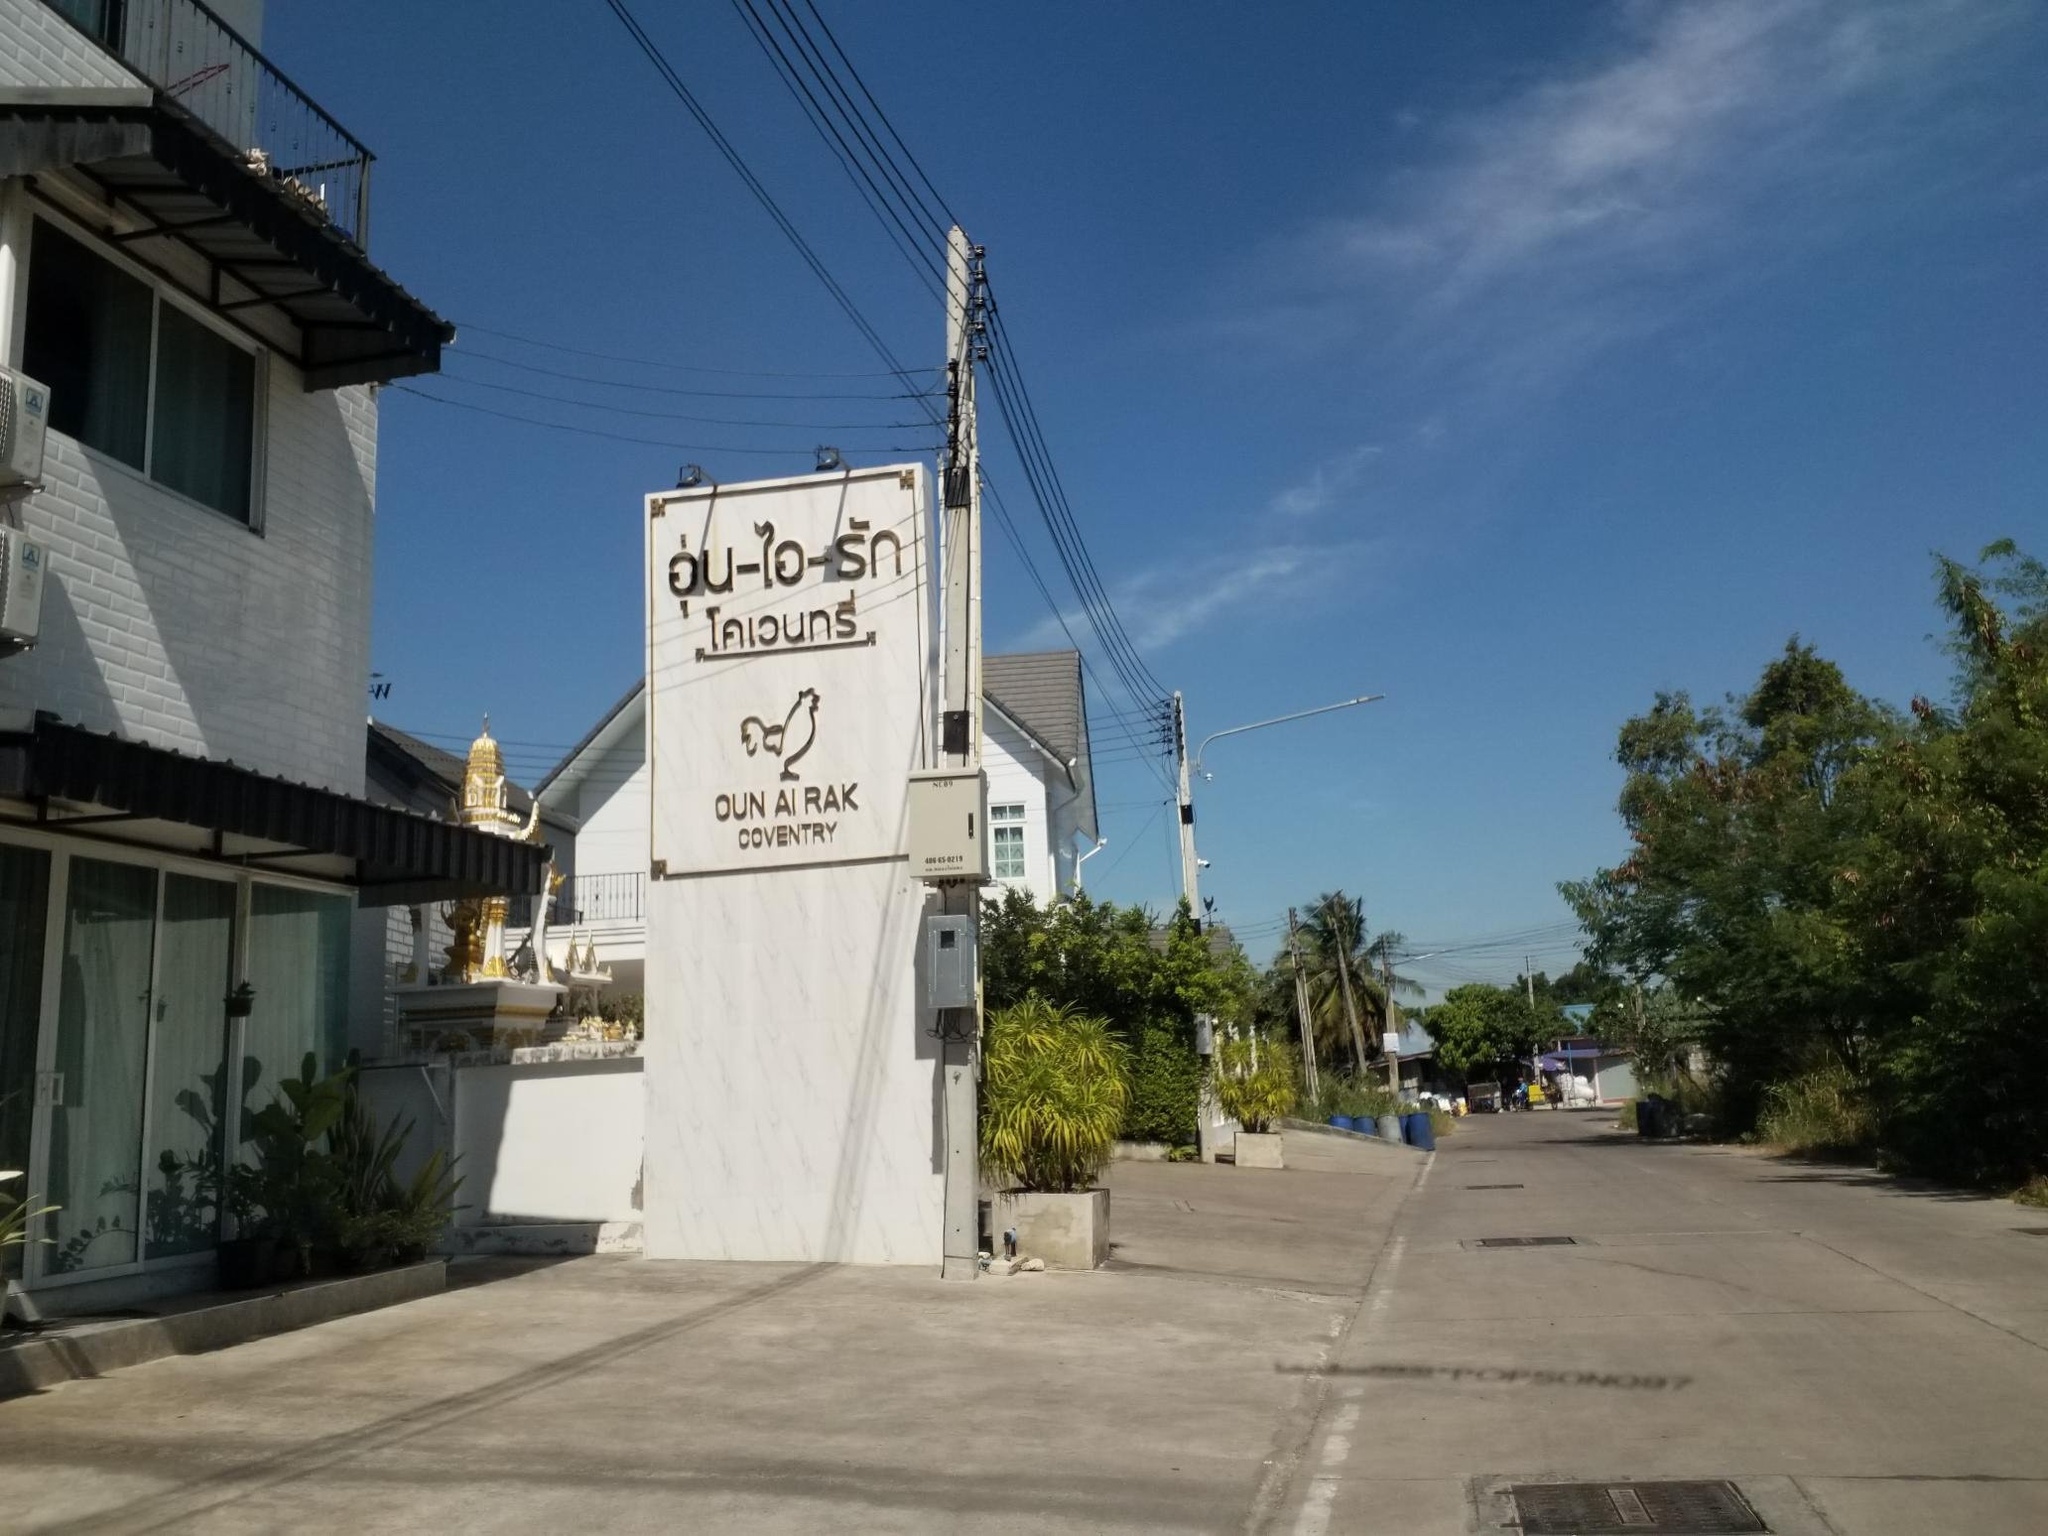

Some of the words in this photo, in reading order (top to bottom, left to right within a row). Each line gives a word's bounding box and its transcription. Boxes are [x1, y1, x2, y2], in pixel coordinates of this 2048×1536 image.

[669, 517, 902, 619] อุ่น-ไอ-รัก
[715, 791, 765, 822] OUN
[775, 787, 796, 817] AI
[804, 782, 859, 815] RAK
[738, 821, 838, 850] COVENTRY
